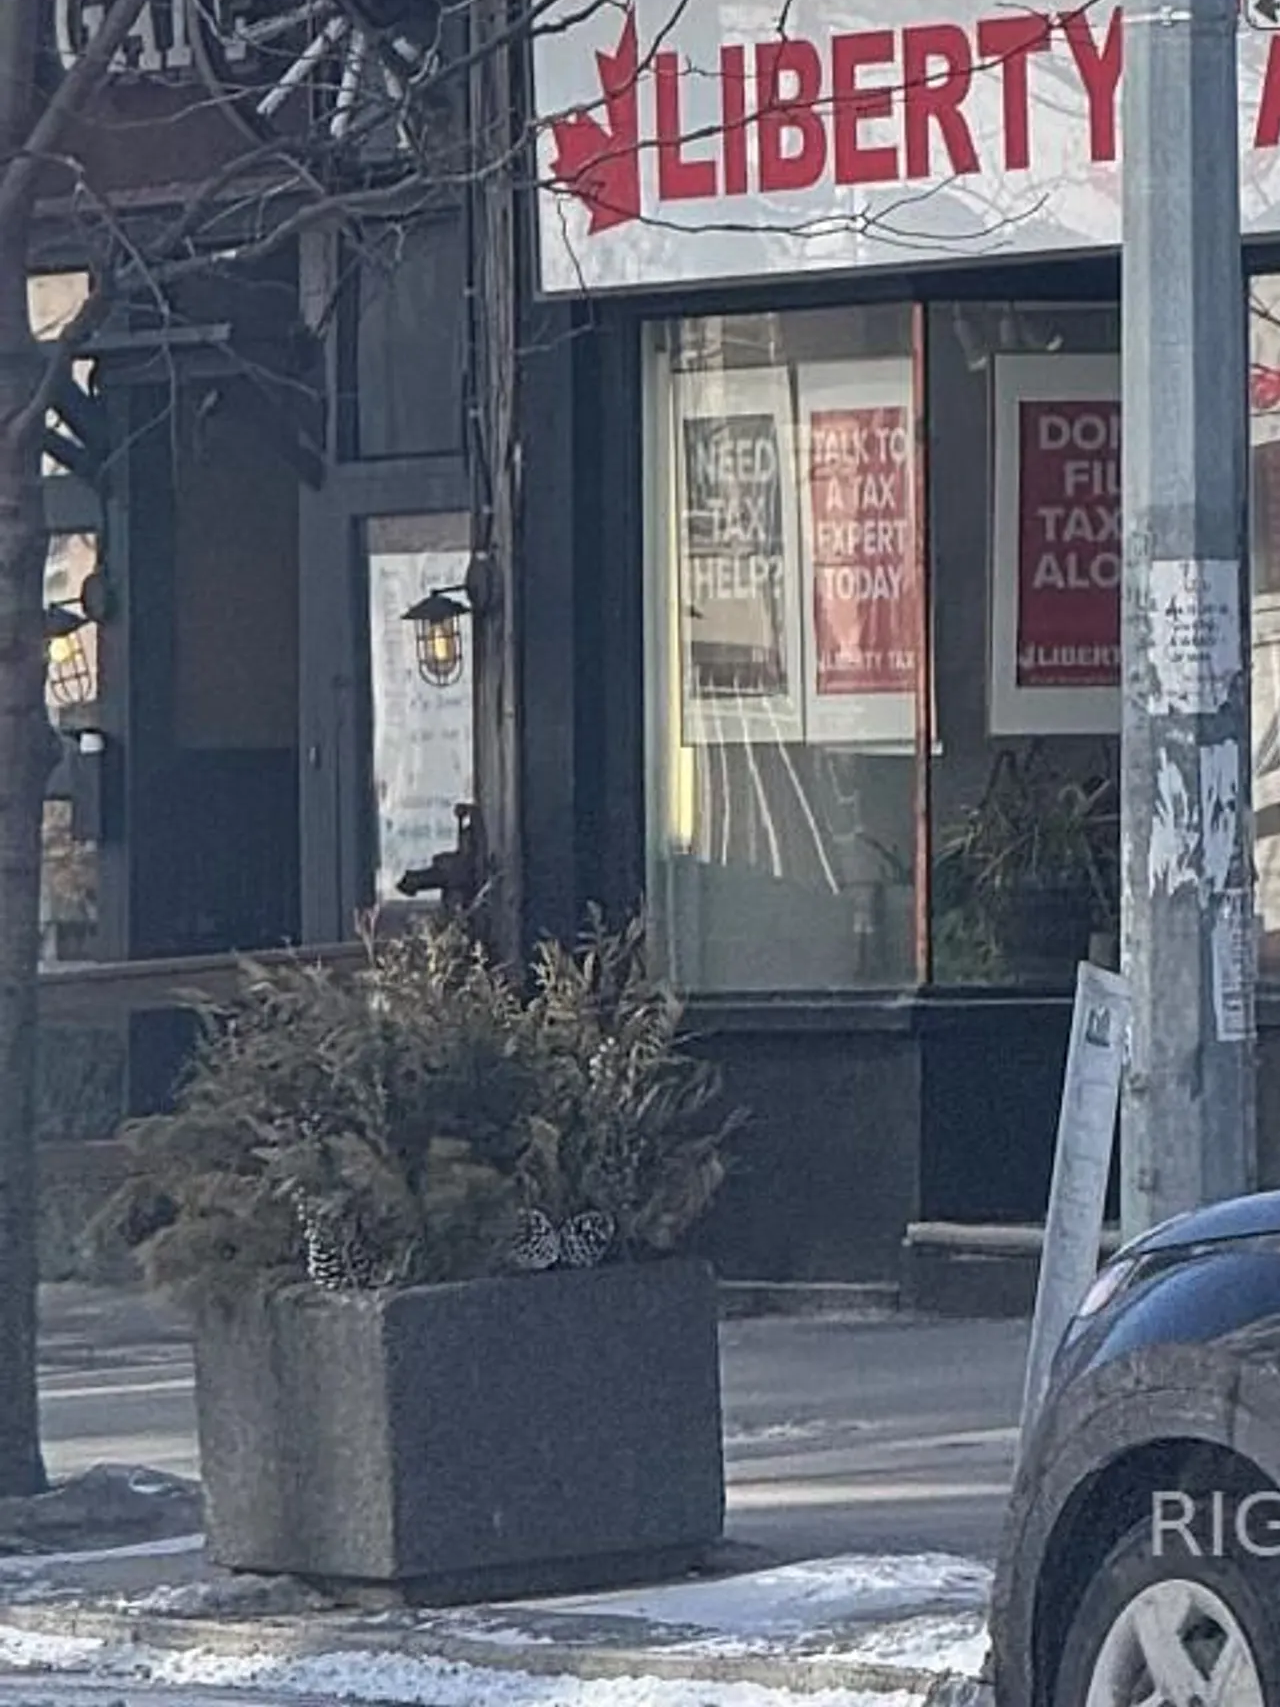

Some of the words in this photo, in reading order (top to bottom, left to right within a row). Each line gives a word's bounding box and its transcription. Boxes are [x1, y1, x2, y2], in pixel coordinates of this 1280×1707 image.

[655, 7, 1122, 203] LIBERTY
[697, 437, 776, 484] NEED
[813, 429, 871, 465] TALK
[877, 426, 908, 466] TO
[826, 475, 845, 511] A
[854, 473, 896, 511] TAX
[706, 496, 768, 542] TAX
[818, 518, 907, 558] EXPERT
[824, 562, 905, 601] TODAY
